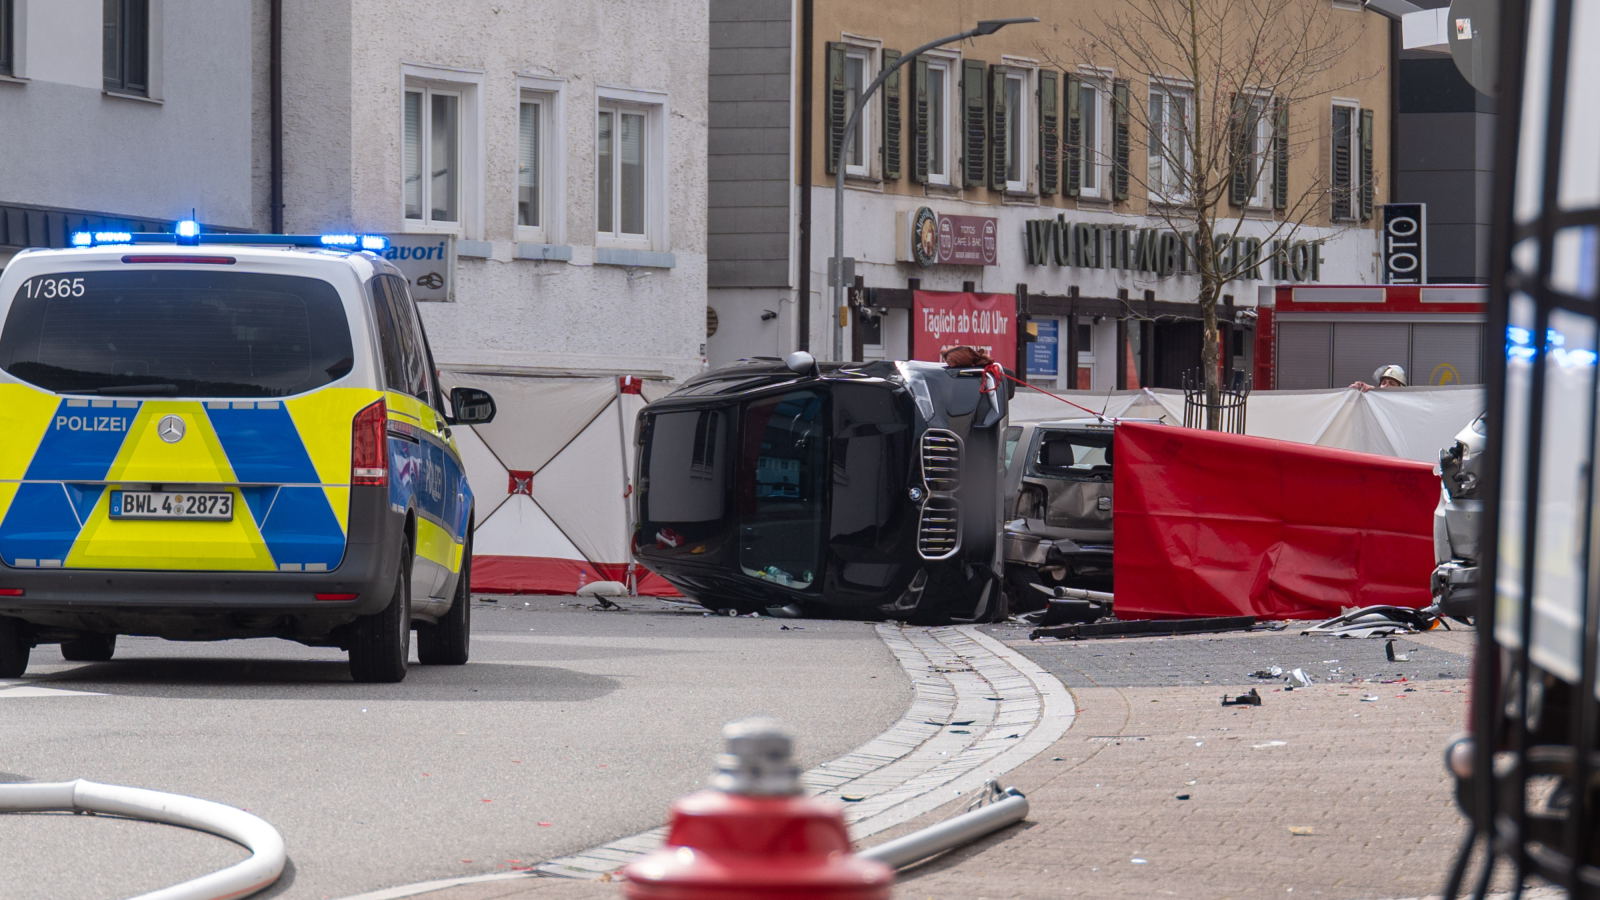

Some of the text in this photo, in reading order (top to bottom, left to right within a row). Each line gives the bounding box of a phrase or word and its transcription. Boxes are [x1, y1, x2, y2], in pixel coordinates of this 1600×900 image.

[380, 241, 445, 260] avori
[971, 236, 982, 248] BAR
[1026, 212, 1326, 282] WÜRTTEMBEGER HOF
[1388, 216, 1418, 284] TOTO
[23, 278, 85, 299] 1/365
[854, 289, 865, 306] 34
[922, 308, 1008, 339] Täglich ab 6.00 Uhr
[56, 415, 127, 432] POLIZEI
[113, 505, 119, 513] D
[123, 494, 230, 515] BWL 4 2873
